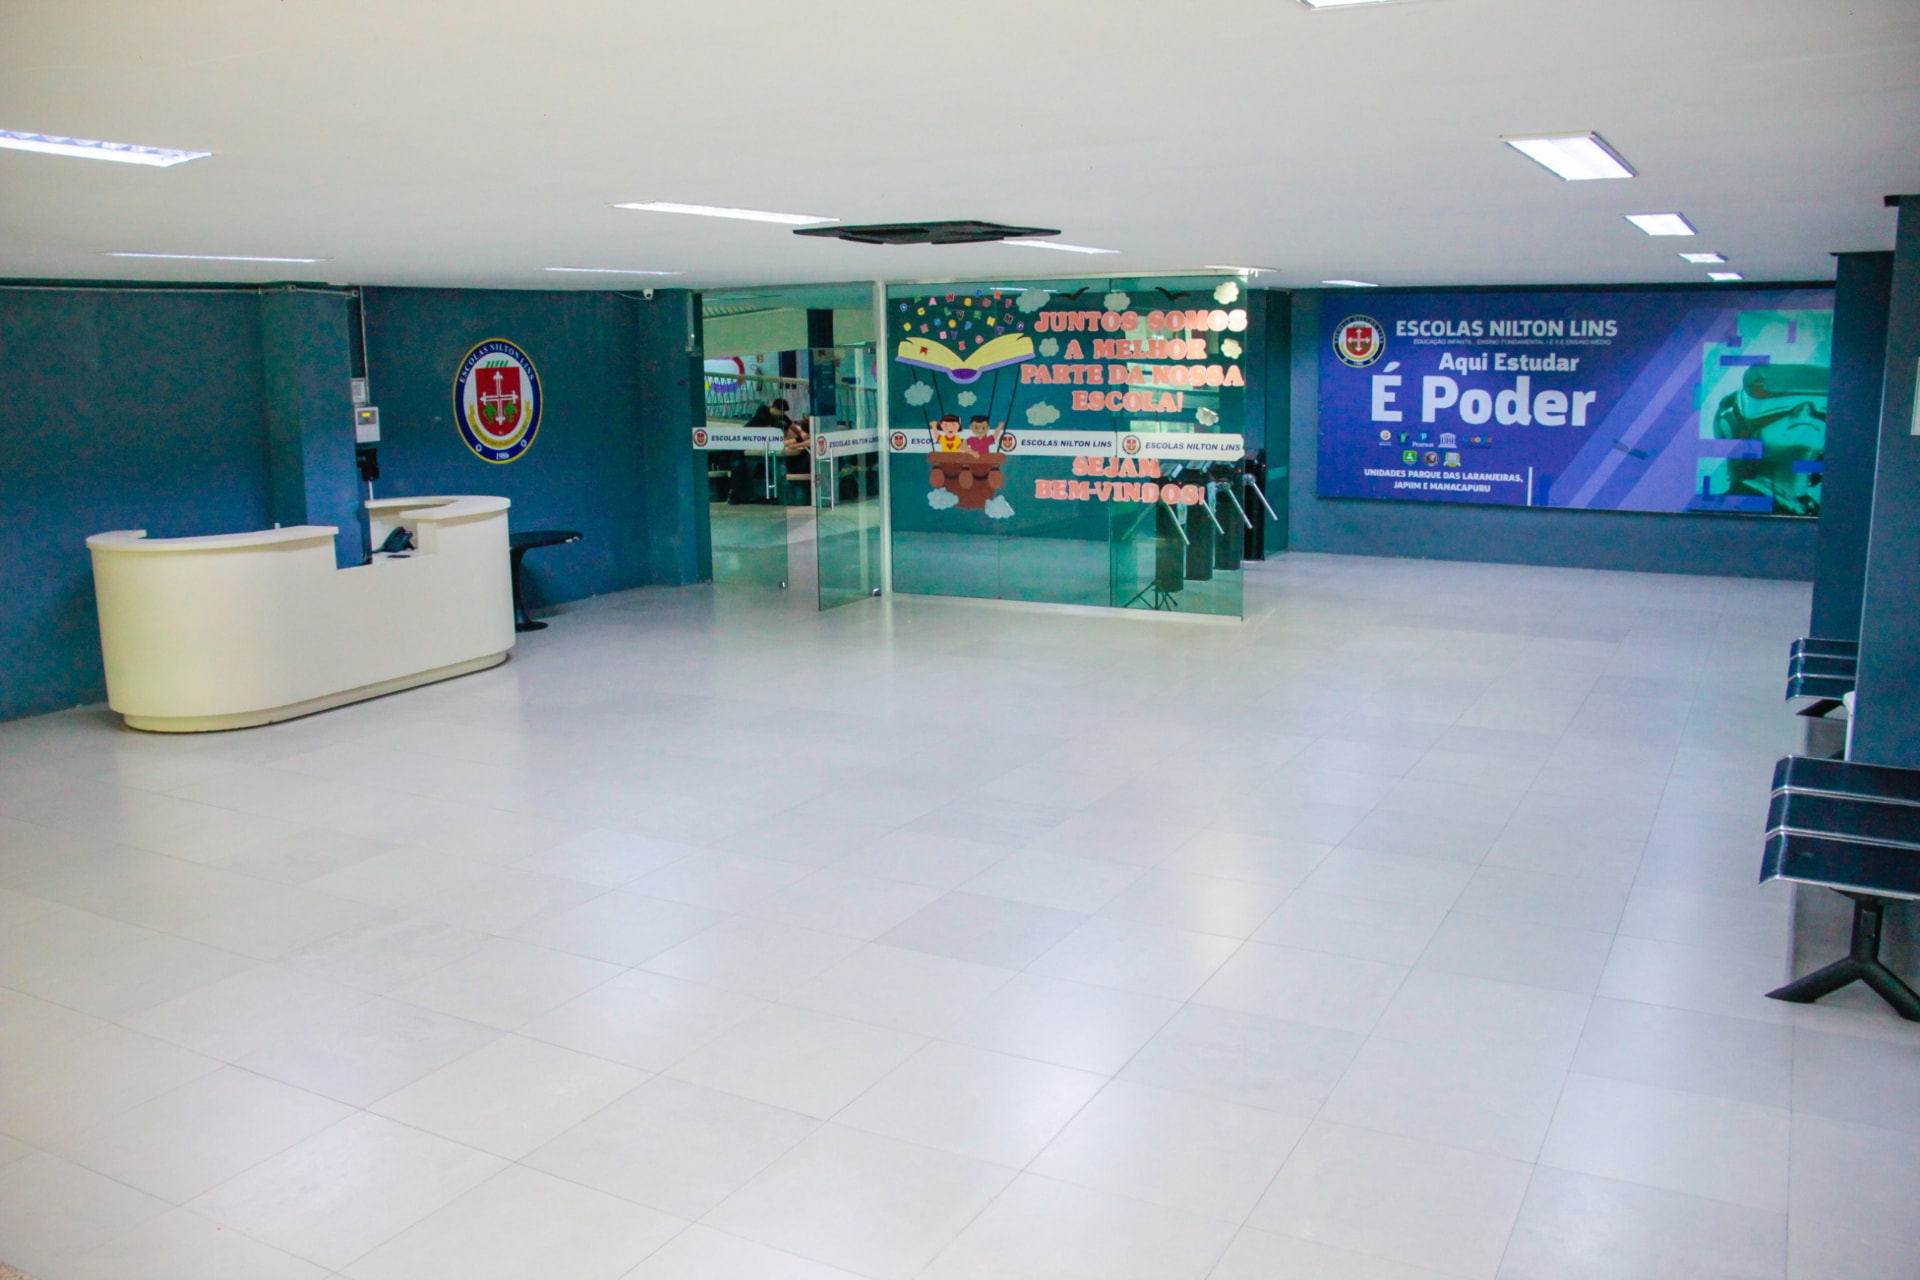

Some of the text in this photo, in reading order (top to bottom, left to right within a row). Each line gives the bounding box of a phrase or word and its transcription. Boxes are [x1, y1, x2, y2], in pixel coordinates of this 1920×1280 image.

[1034, 309, 1248, 333] JUNTOS SOMOS
[1396, 320, 1484, 337] ESCOLAS
[1489, 320, 1564, 337] NILTON
[1569, 320, 1618, 337] LINS
[1064, 338, 1207, 360] A MELHOR
[458, 347, 489, 384] ESCOLAS
[489, 343, 519, 359] NILTON
[1438, 352, 1580, 376] Aqui Estudar
[1020, 364, 1245, 387] PARTE DA NOSSA
[1072, 390, 1184, 412] ESCOLA!
[1371, 361, 1597, 426] É Poder
[1021, 439, 1058, 447] ESCOLAS
[1093, 440, 1112, 448] LINS
[1145, 442, 1184, 450] ESCOLAS
[1186, 443, 1218, 451] NILTON
[1072, 456, 1161, 478] SEJAM
[1364, 468, 1524, 483] UNIDADES PARQUE DAS LARANJEIRAS,
[1035, 479, 1206, 505] BEM-VINDOS!
[1393, 480, 1492, 492] JAPIIM E MANACAPURU
